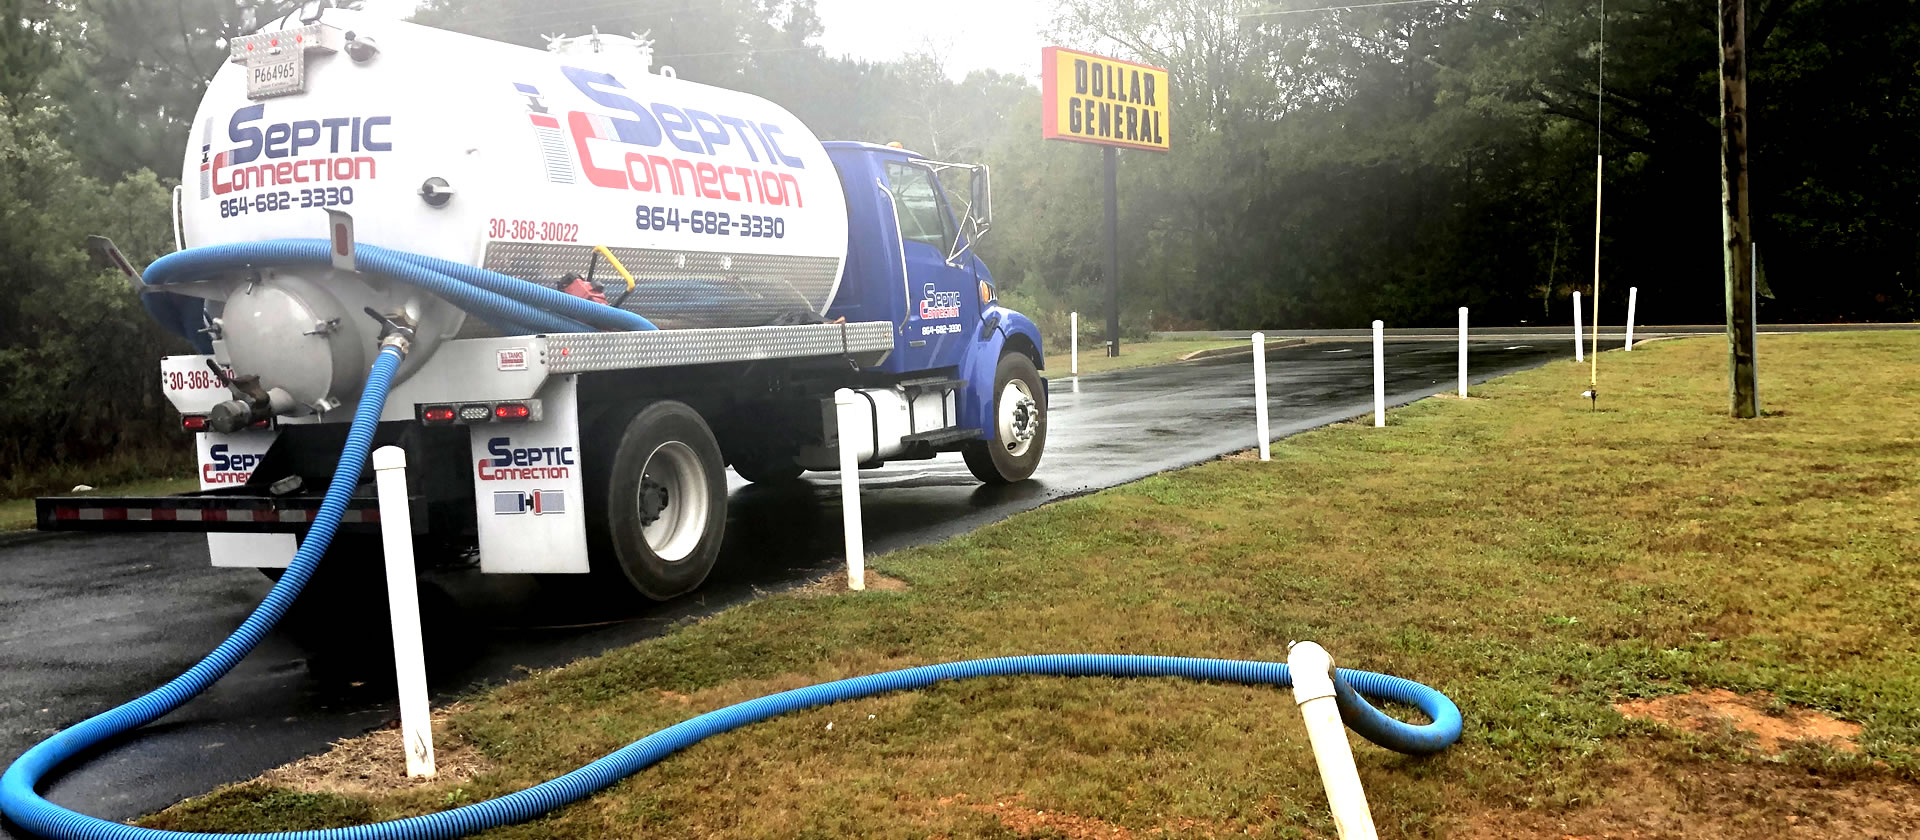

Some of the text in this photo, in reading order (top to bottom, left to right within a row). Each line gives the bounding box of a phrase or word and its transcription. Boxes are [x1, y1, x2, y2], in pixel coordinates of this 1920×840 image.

[254, 62, 295, 84] P664965
[1074, 58, 1156, 107] DOLLAR
[1069, 96, 1163, 145] GENERAL
[220, 186, 354, 219] 864-682-3330
[488, 217, 579, 243] 30-368-30022
[635, 205, 785, 240] 864-682-3330
